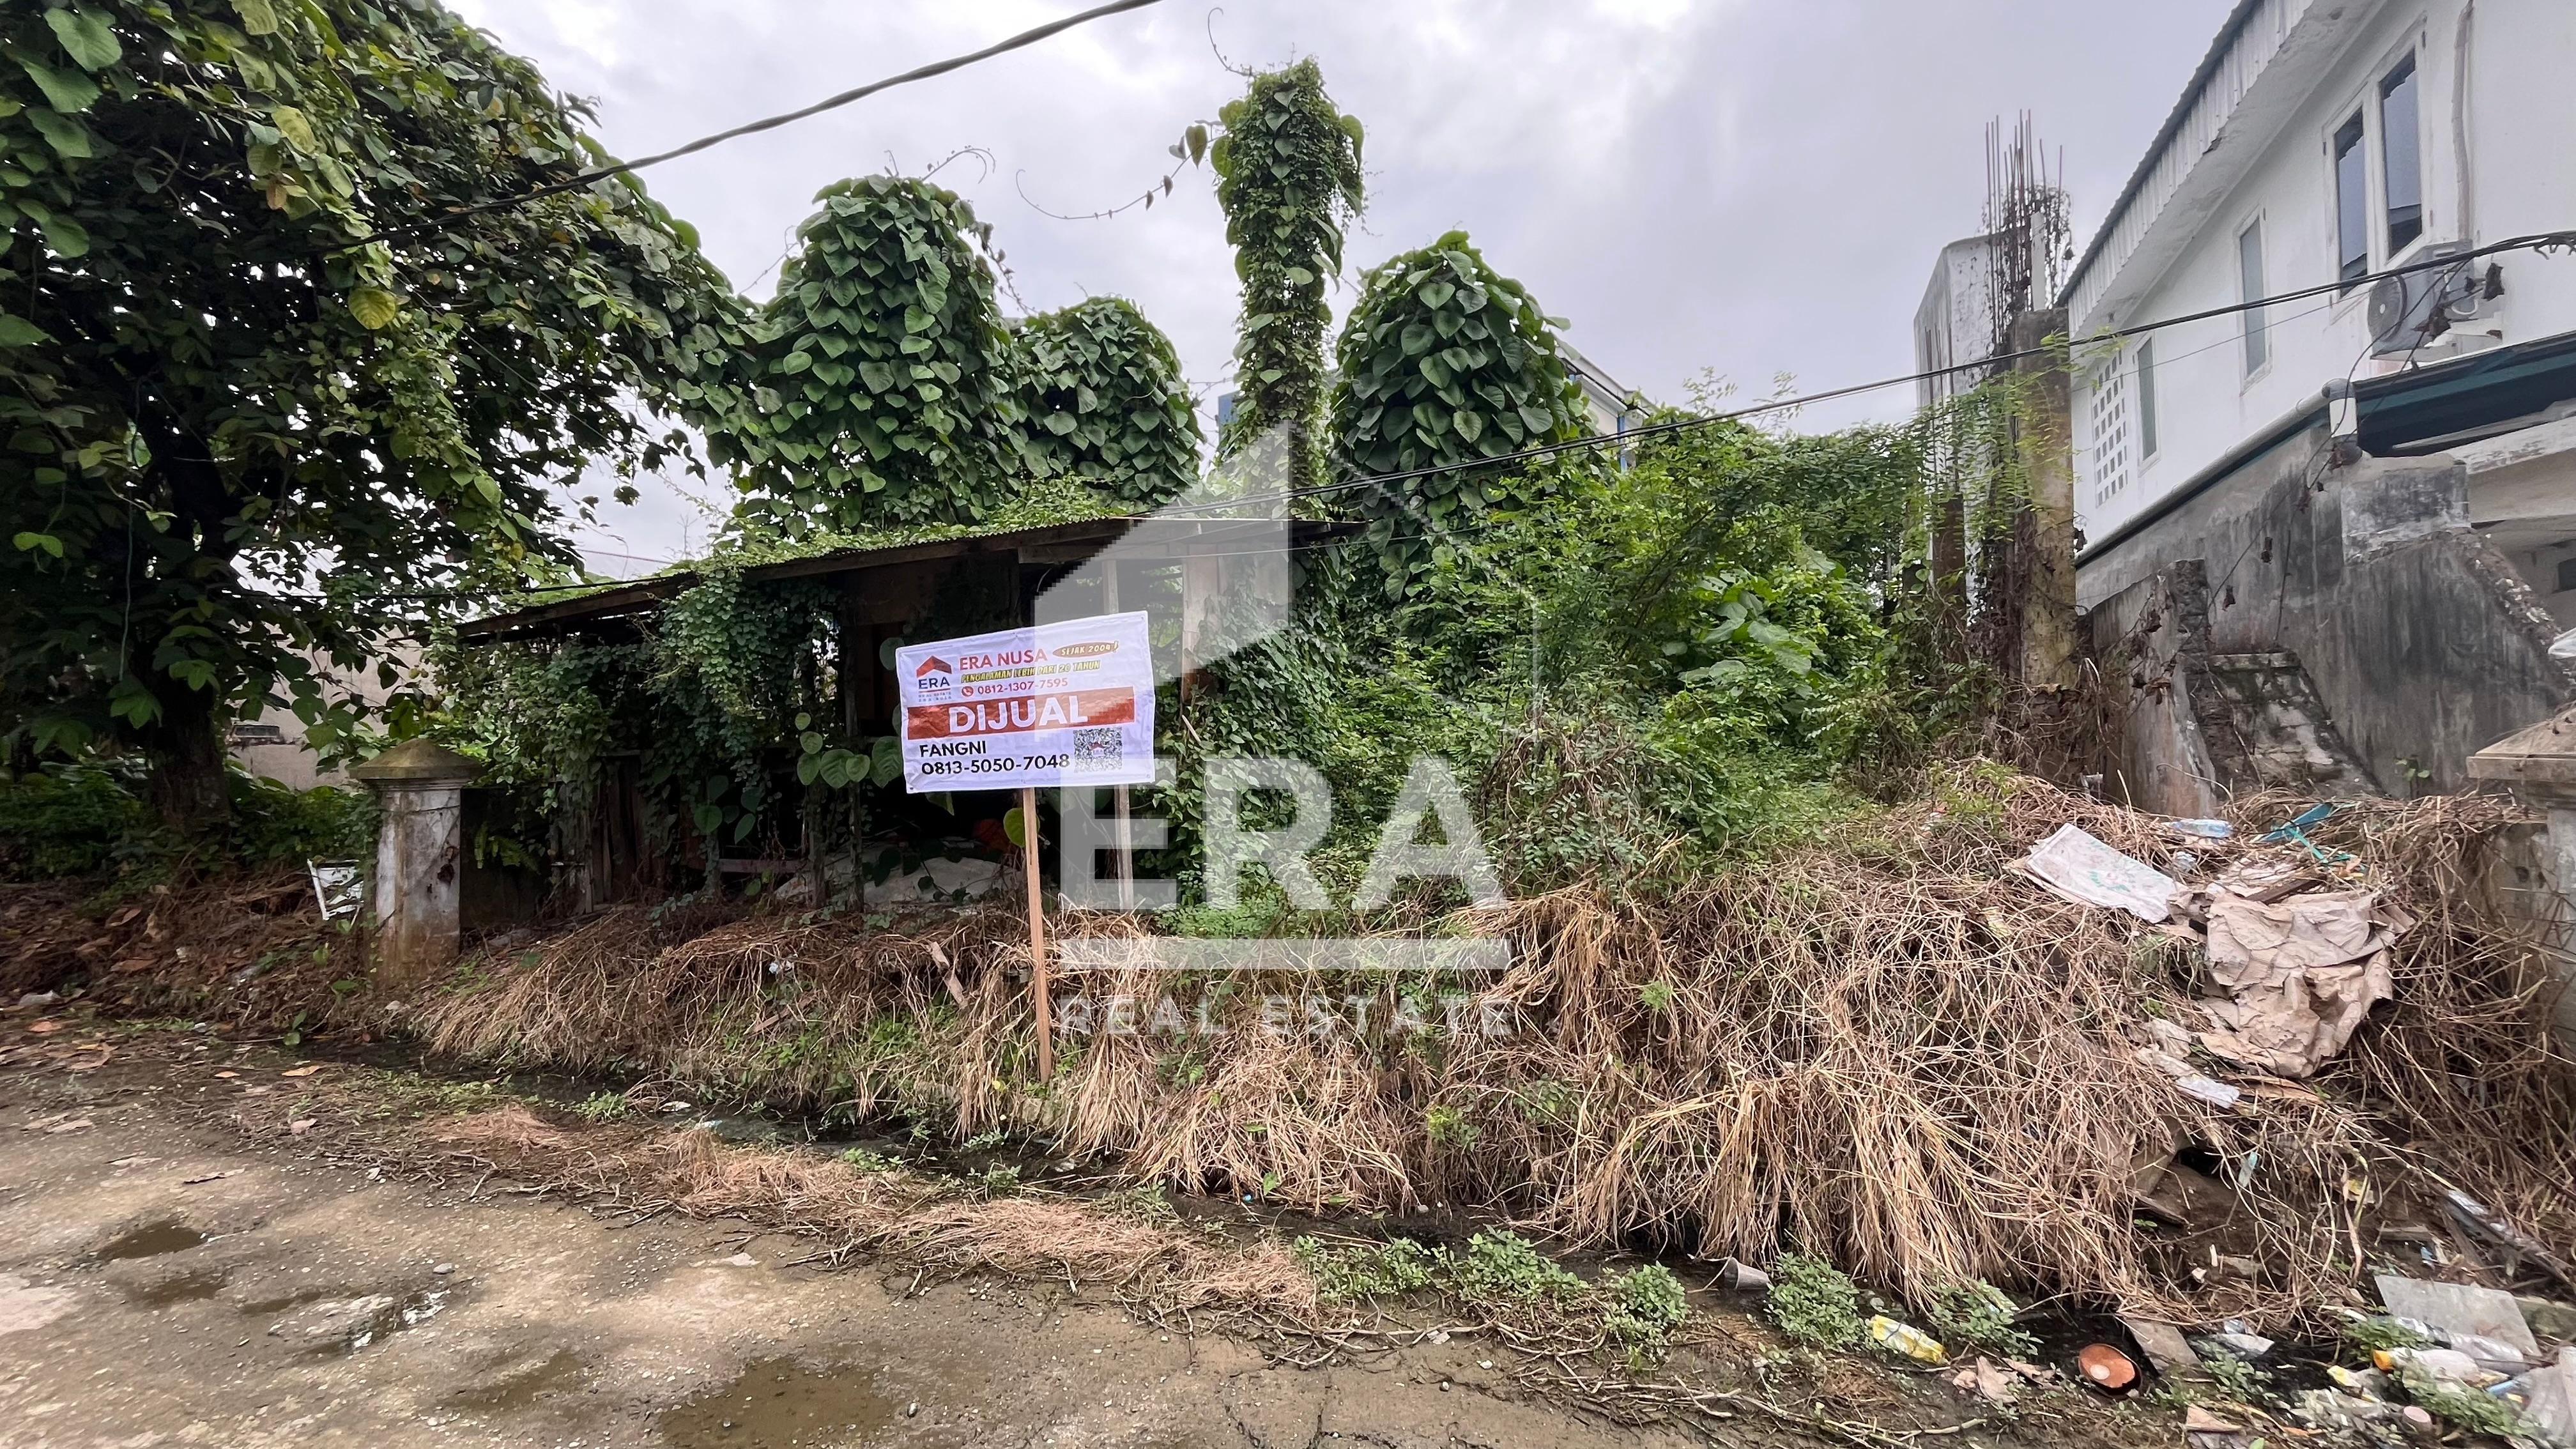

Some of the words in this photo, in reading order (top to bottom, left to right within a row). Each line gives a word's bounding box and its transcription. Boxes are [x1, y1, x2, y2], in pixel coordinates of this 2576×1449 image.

[960, 654, 993, 670] ERA
[997, 648, 1048, 666] NUSA
[1061, 646, 1085, 656] SEJAK
[1013, 666, 1036, 677] LEBIH
[1037, 664, 1057, 675] DARI
[1058, 663, 1071, 673] 20
[1073, 660, 1100, 671] TAHUN
[918, 677, 951, 689] ERA
[977, 678, 1068, 694] 0812-1307-7595
[949, 695, 1089, 733] DIJUAL
[919, 740, 986, 757] FANGNI
[922, 753, 1070, 775] 0813-5050-7048
